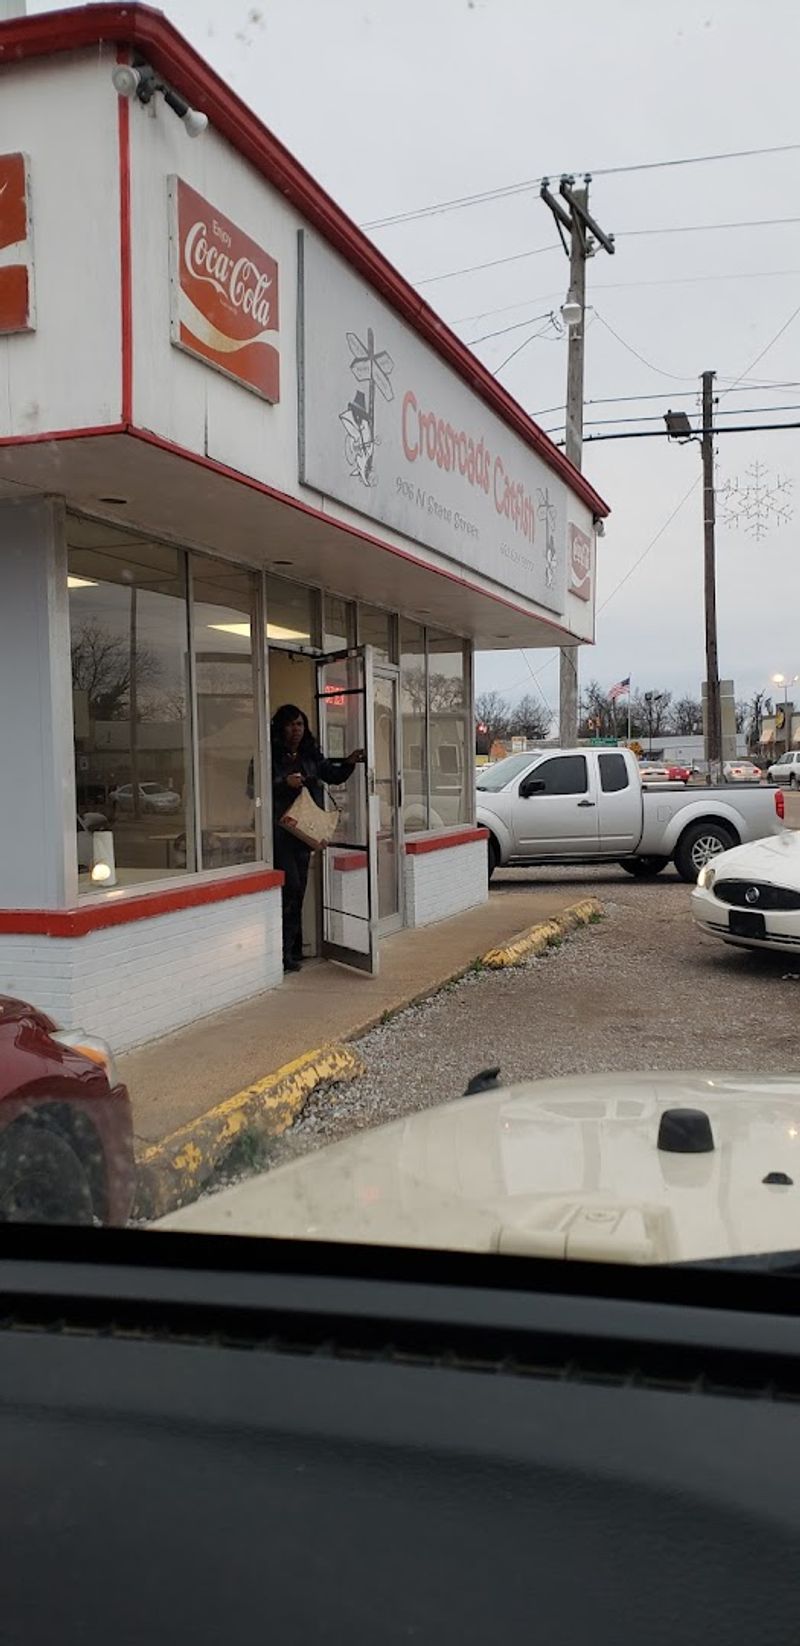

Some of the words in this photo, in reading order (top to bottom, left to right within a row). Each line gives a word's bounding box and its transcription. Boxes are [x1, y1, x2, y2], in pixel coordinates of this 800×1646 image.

[184, 221, 272, 327] Coca-Cola
[402, 390, 490, 495] Crossroads
[493, 456, 535, 544] Catfish
[416, 487, 427, 508] N
[427, 495, 453, 522] State
